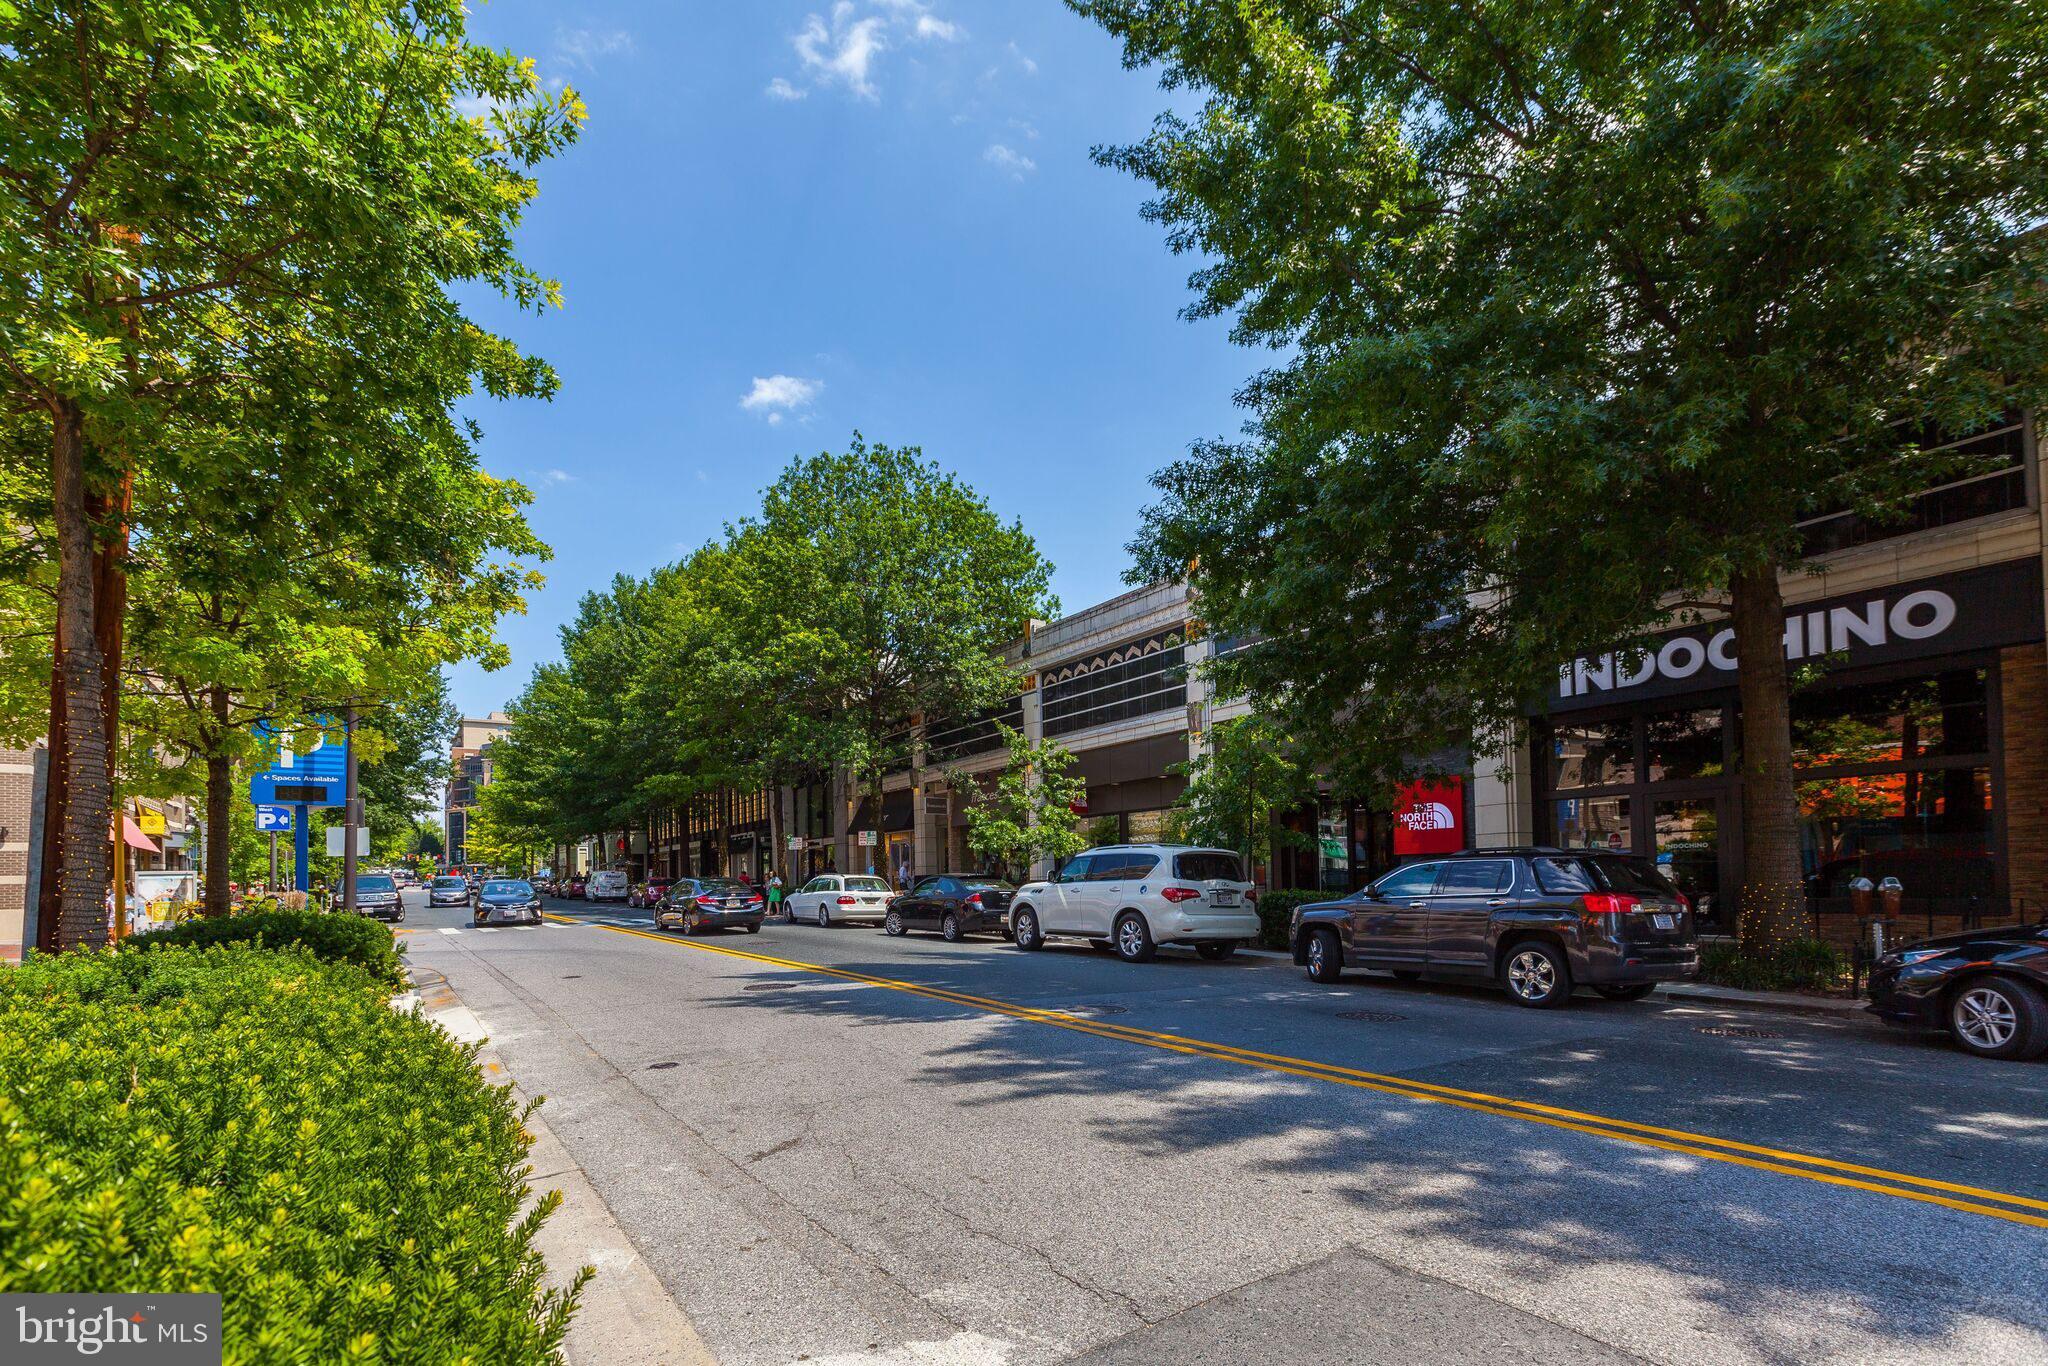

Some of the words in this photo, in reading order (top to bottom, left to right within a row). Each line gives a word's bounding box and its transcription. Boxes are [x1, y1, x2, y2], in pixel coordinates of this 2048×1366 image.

[1413, 803, 1433, 812] THE
[258, 813, 276, 829] P
[1400, 811, 1433, 822] NORTH
[1408, 820, 1433, 830] FACE
[1665, 842, 1709, 850] INDOCHINO
